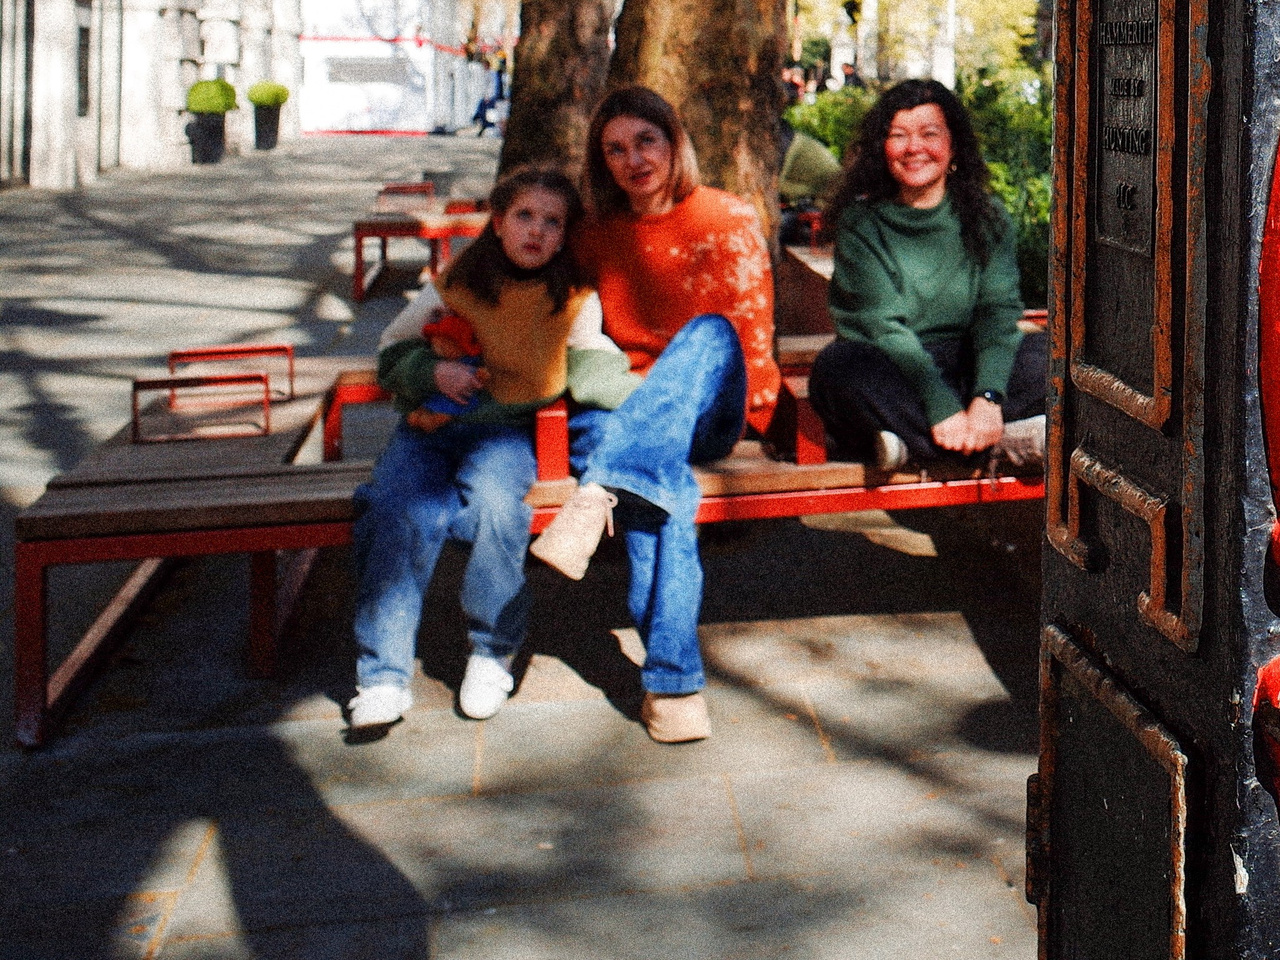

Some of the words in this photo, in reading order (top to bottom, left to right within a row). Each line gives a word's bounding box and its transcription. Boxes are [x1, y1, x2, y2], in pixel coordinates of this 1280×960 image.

[1100, 20, 1153, 45] HAMMERITE
[1108, 78, 1128, 96] MADE
[1130, 78, 1140, 97] BY
[1102, 126, 1147, 153] HUNTING
